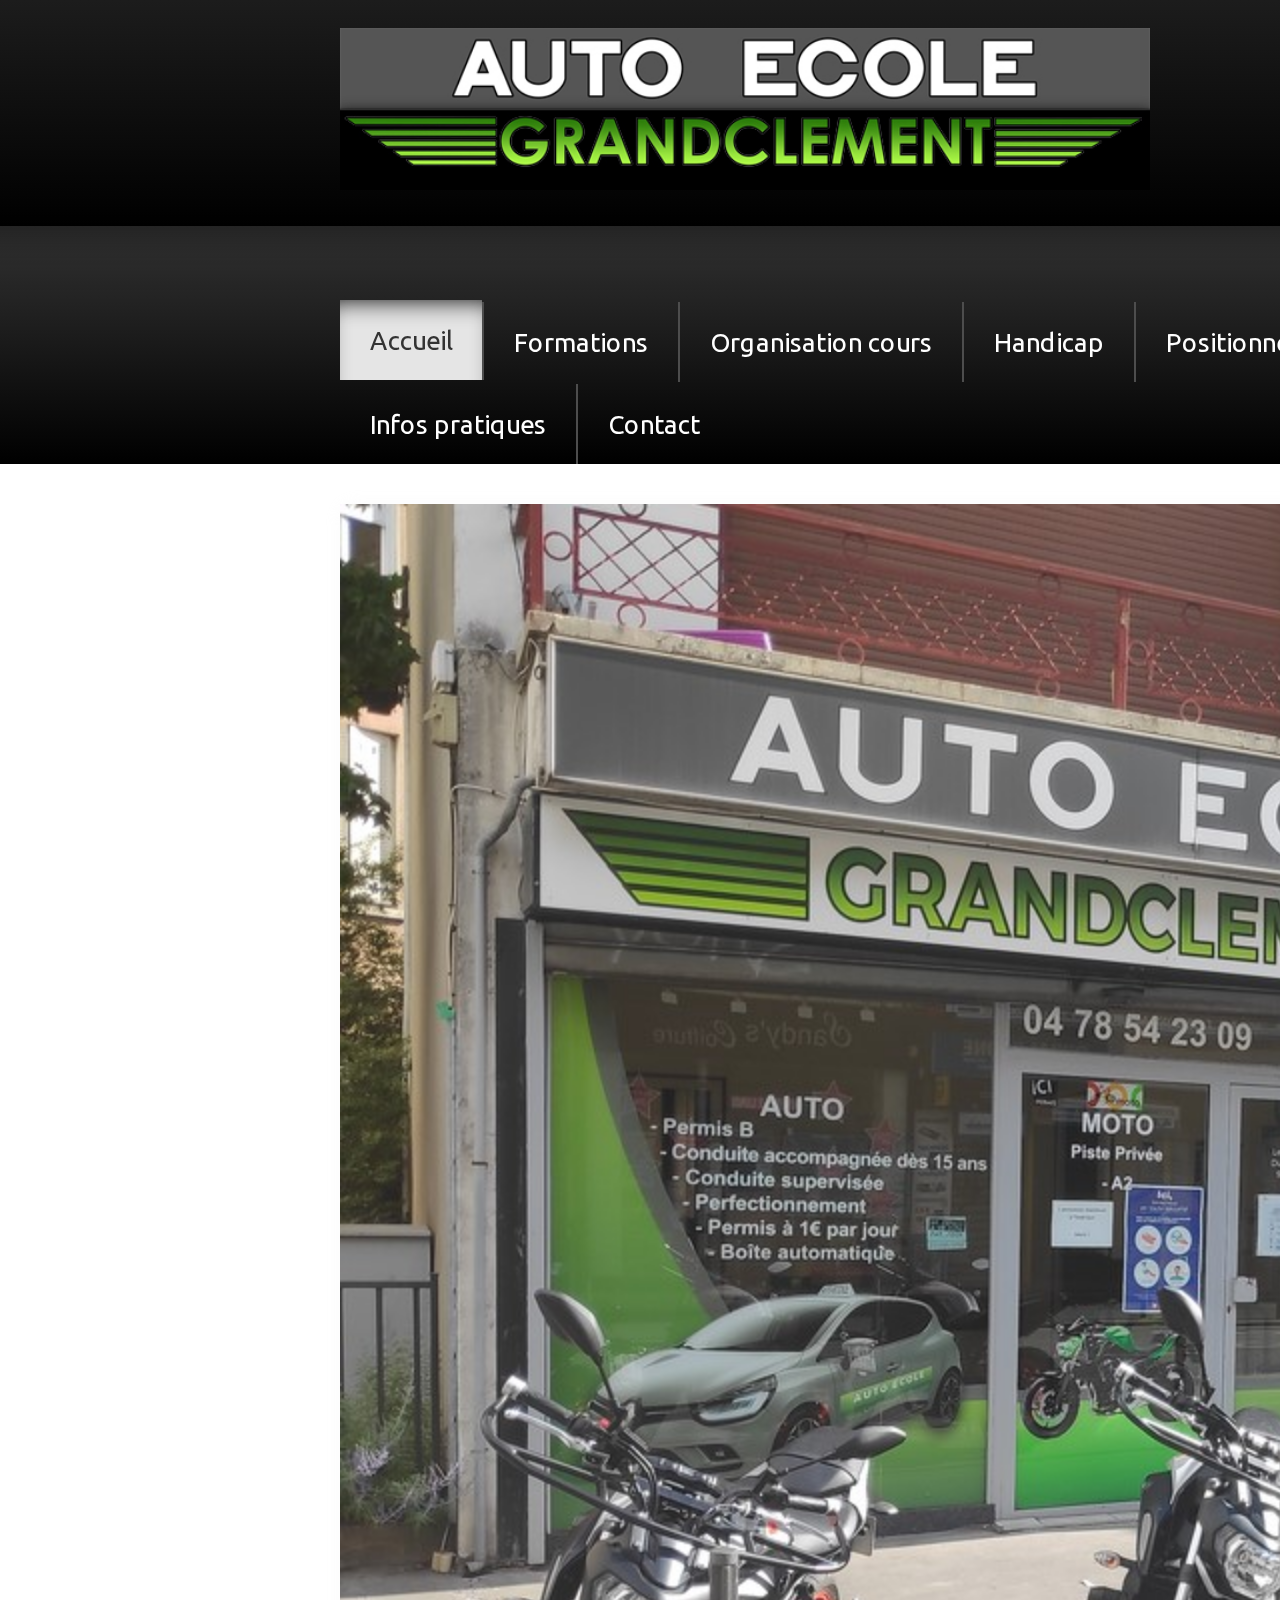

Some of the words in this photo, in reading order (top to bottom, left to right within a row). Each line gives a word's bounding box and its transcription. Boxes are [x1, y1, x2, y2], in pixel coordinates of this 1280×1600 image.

[454, 38, 683, 98] AUTO
[742, 38, 1038, 98] ECOLE
[500, 116, 992, 168] GRANDCLEMENT
[369, 329, 453, 351] Accueil
[515, 332, 647, 353] Formations
[711, 332, 862, 358] Organisation
[868, 337, 932, 353] cours
[995, 331, 1103, 358] Handicap
[371, 413, 427, 435] Infos
[435, 414, 545, 440] pratiques
[609, 415, 701, 435] Contact
[729, 695, 1114, 831] AUTO
[1023, 1004, 1064, 1037] 04
[1075, 1009, 1112, 1041] 78
[1124, 1013, 1161, 1044] 54
[1170, 1017, 1207, 1047] 23
[1217, 1021, 1252, 1051] 09
[760, 1094, 844, 1121] AUTO
[663, 1119, 733, 1138] Permis
[740, 1122, 754, 1138] B
[1082, 1112, 1154, 1135] MOTO
[672, 1144, 759, 1164] Conduite
[764, 1150, 892, 1171] accompagnée
[897, 1152, 928, 1169] dès
[934, 1154, 953, 1170] 15
[958, 1158, 988, 1172] ans
[1071, 1144, 1110, 1161] Piste
[1115, 1146, 1163, 1163] Privée
[685, 1169, 776, 1188] Conduite
[781, 1174, 885, 1192] supervisée
[1111, 1176, 1133, 1190] A2
[695, 1194, 867, 1215] Perfectionnement
[708, 1219, 777, 1237] Permis
[783, 1220, 794, 1237] à
[800, 1221, 821, 1238] 1€
[827, 1225, 856, 1241] par
[861, 1222, 899, 1241] jour
[720, 1243, 773, 1262] Boîte
[777, 1245, 896, 1265] automatique
